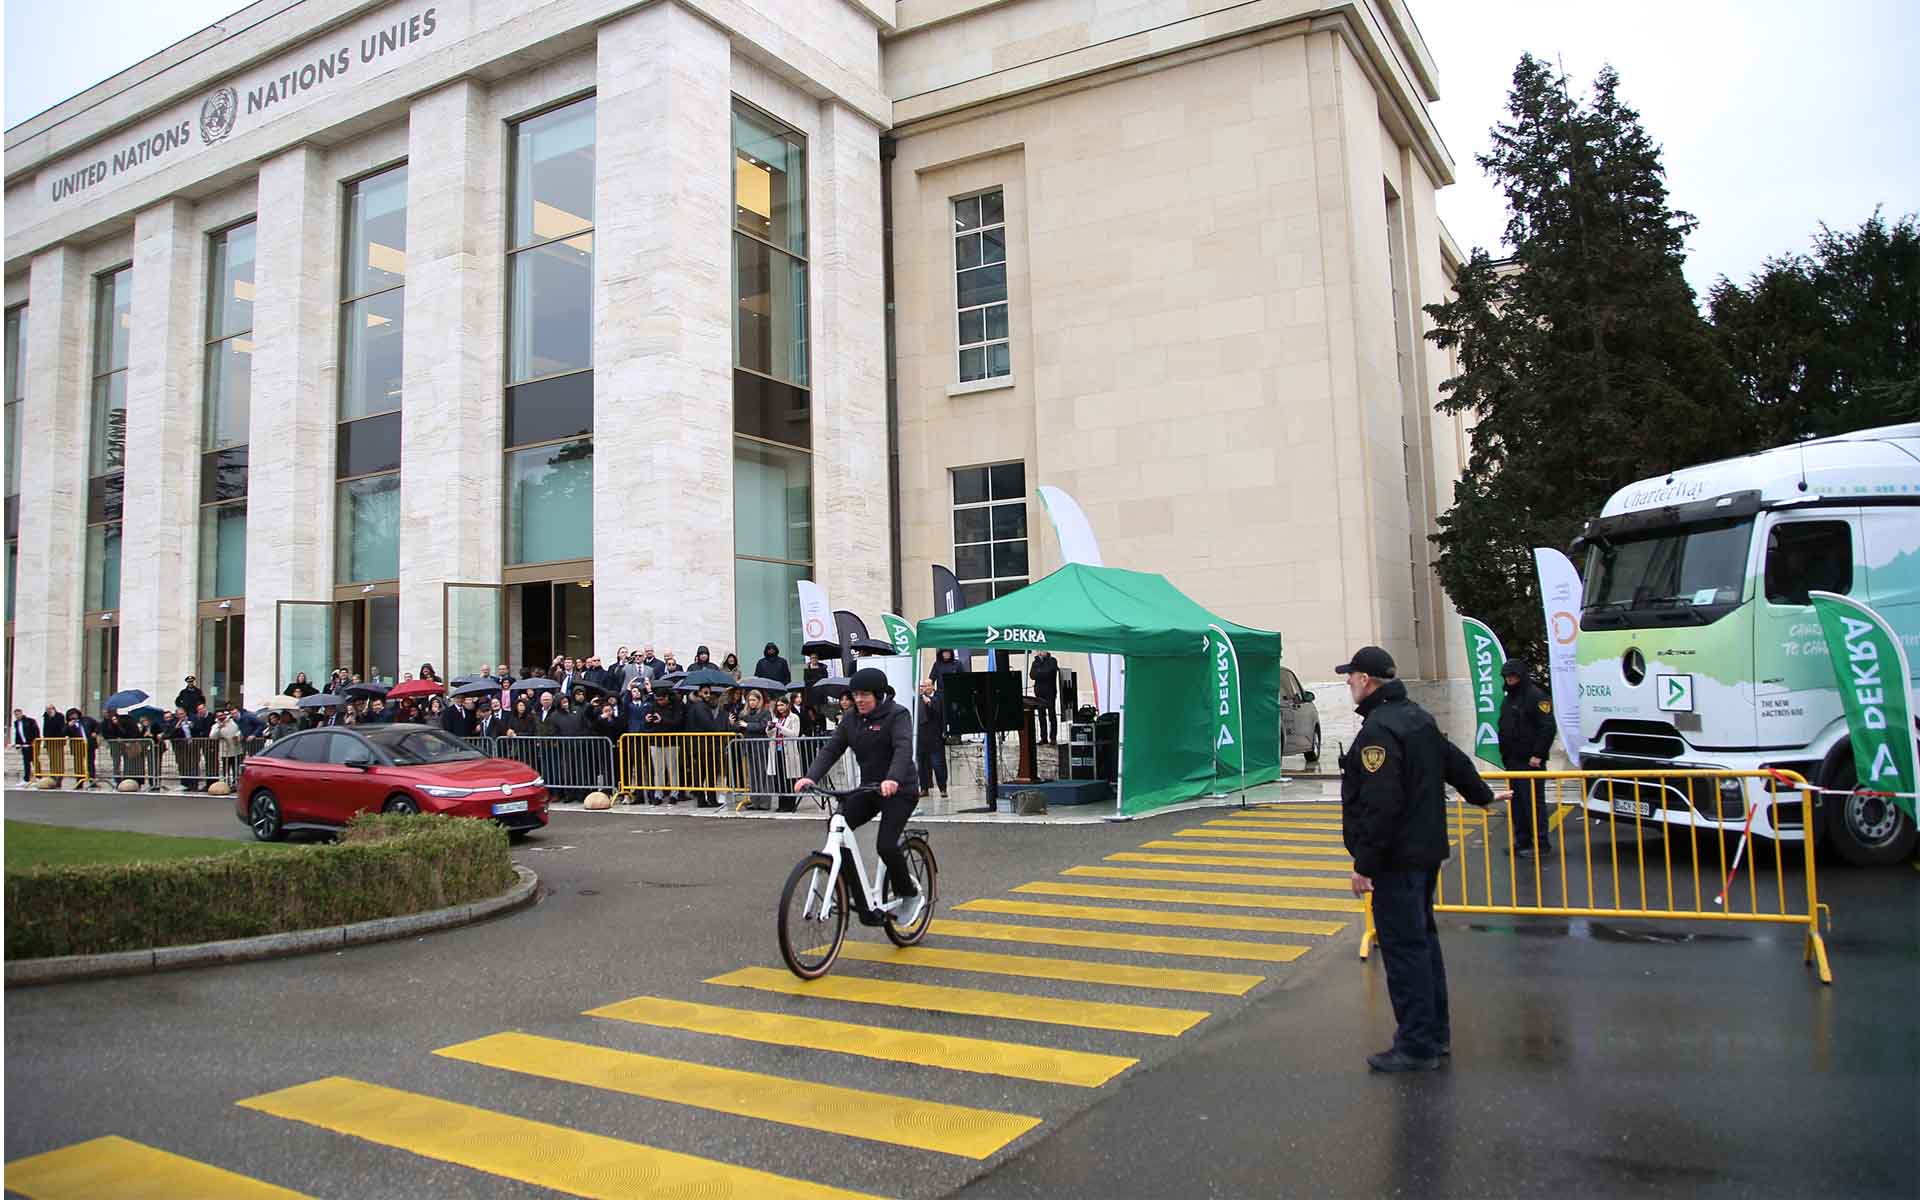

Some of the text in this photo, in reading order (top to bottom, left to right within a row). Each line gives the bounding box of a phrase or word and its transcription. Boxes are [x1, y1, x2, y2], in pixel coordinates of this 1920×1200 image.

[247, 8, 437, 114] NATIONS UNIES
[51, 120, 190, 202] UNITED NATIONS
[1003, 628, 1046, 643] DEKRA
[1585, 685, 1612, 697] DEKRA
